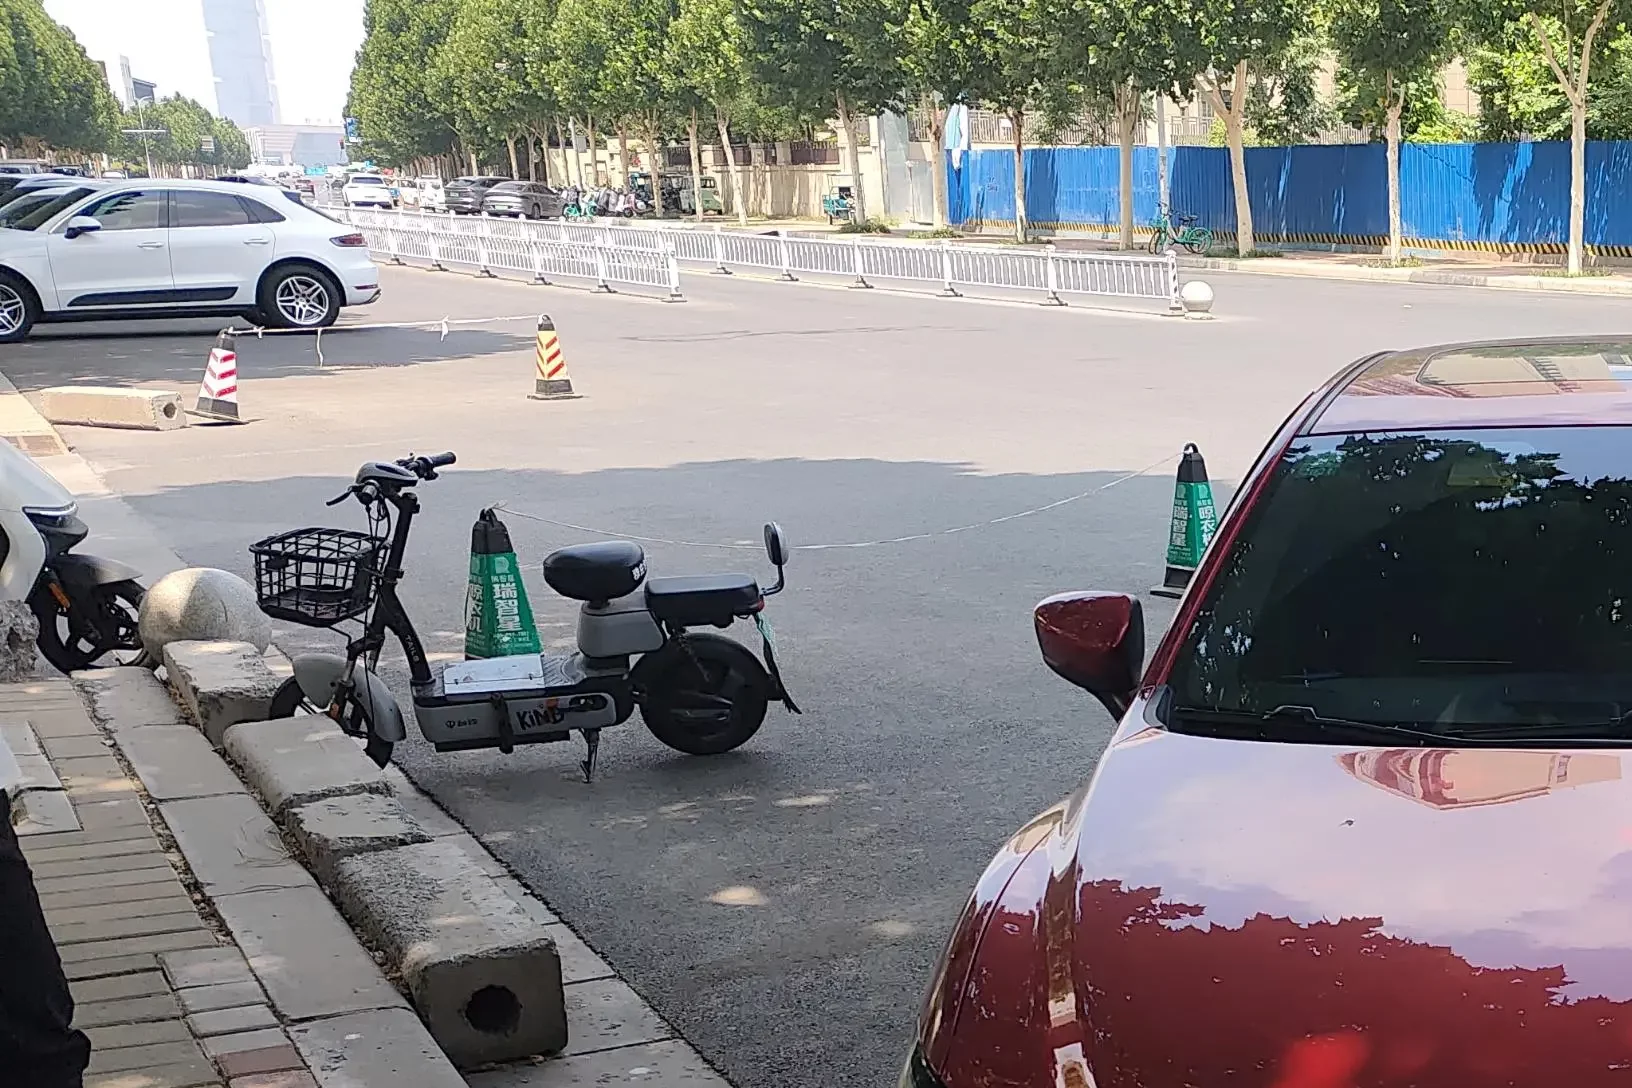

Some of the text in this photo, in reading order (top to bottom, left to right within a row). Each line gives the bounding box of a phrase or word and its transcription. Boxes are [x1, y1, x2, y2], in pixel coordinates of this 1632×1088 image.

[1172, 506, 1188, 546] 瑞智星
[493, 582, 522, 632] 瑞智星
